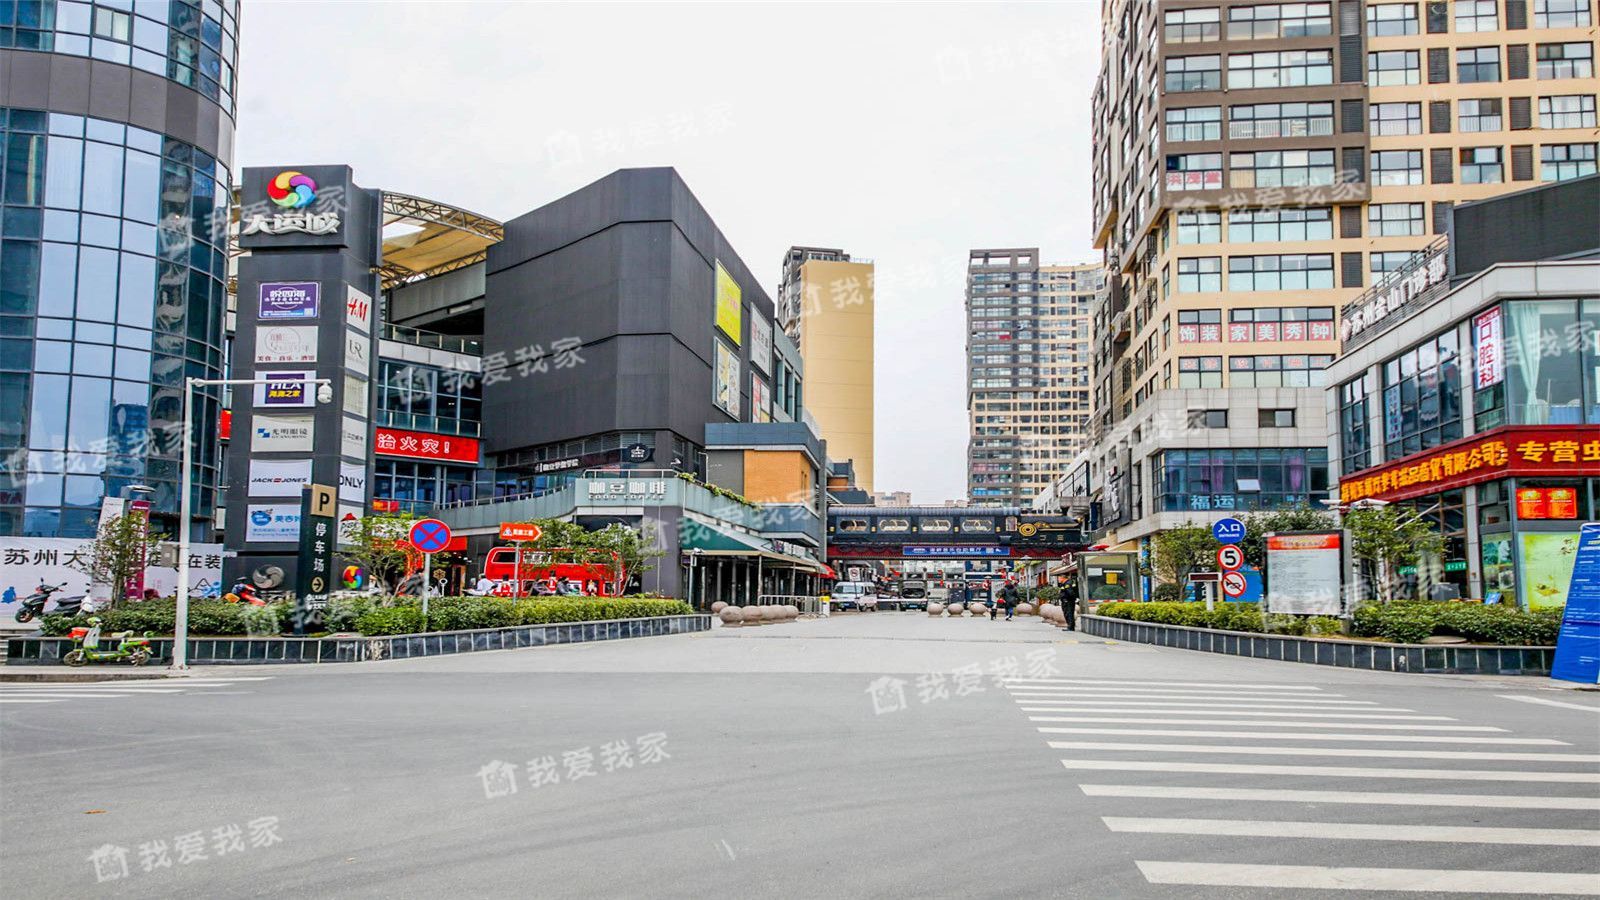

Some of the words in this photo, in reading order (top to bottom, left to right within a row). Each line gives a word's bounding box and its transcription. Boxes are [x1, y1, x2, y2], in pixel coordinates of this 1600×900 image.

[1351, 252, 1448, 336] 苏州金山门诊部
[1479, 321, 1496, 386] 口腔科
[339, 475, 364, 489] ONLY
[319, 492, 330, 512] P
[1190, 494, 1235, 510] 福运
[1218, 524, 1241, 533] 入口
[313, 523, 327, 572] 停车场
[1224, 550, 1236, 566] 5
